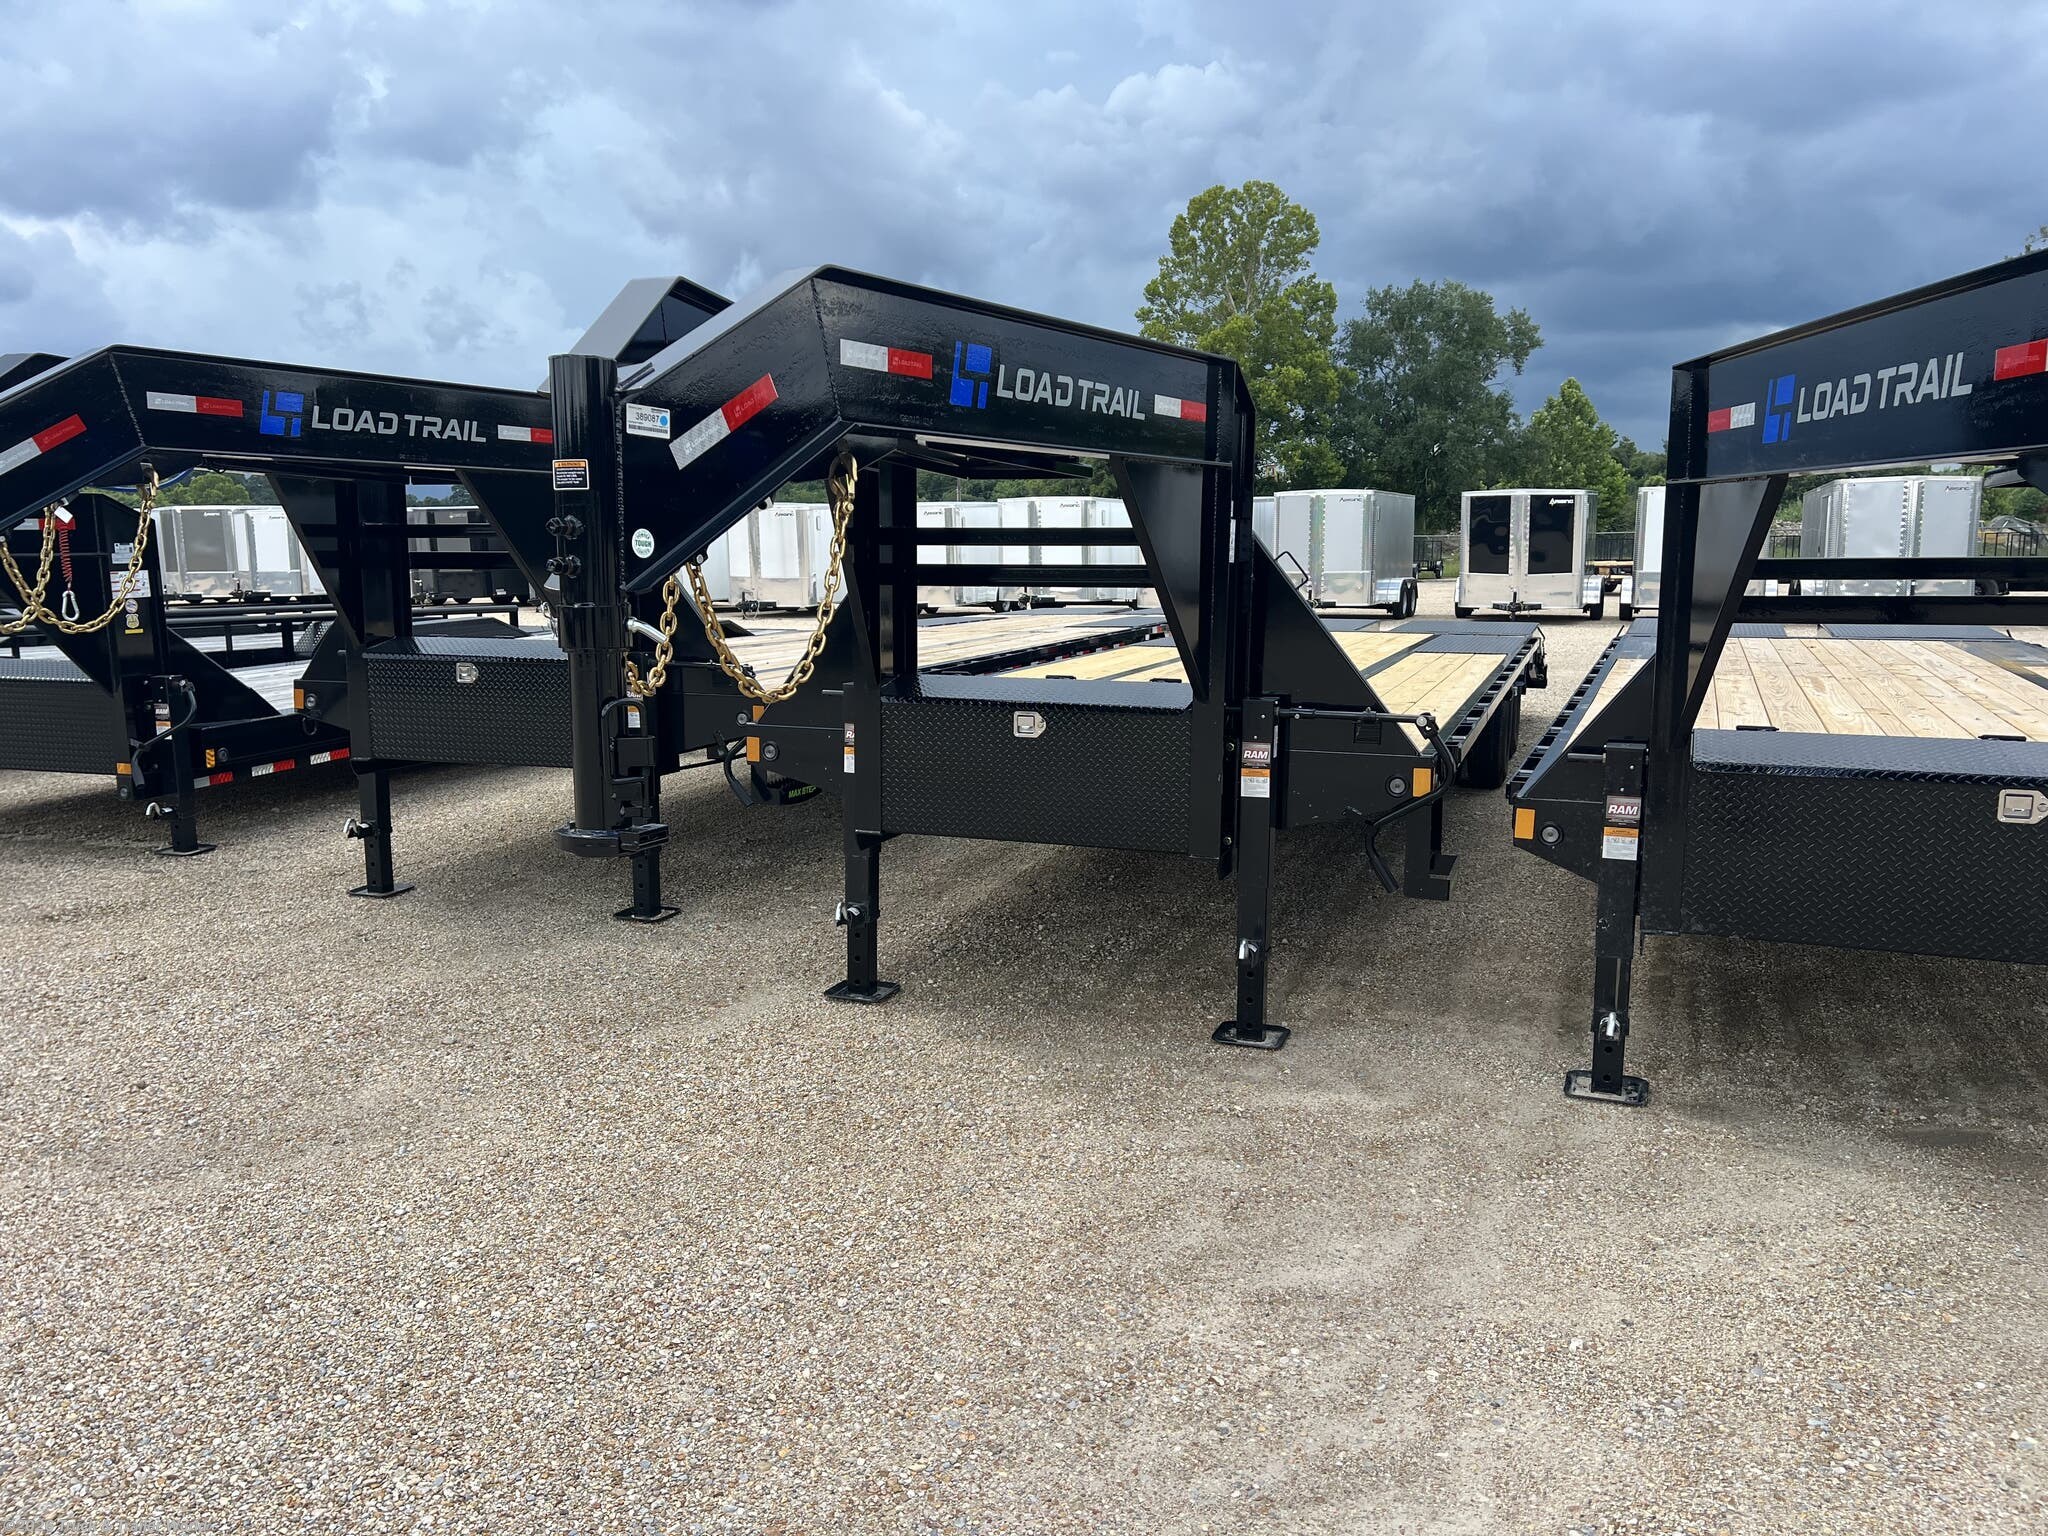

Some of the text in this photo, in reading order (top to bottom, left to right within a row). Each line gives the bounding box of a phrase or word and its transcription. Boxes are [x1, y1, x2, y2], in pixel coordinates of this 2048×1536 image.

[997, 364, 1146, 421] LOAD TRAIL
[1797, 352, 1972, 423] LOAD TRAIL
[311, 405, 487, 443] LOAD TRAIL
[1243, 750, 1269, 760] RAM
[1607, 804, 1639, 815] RAM
